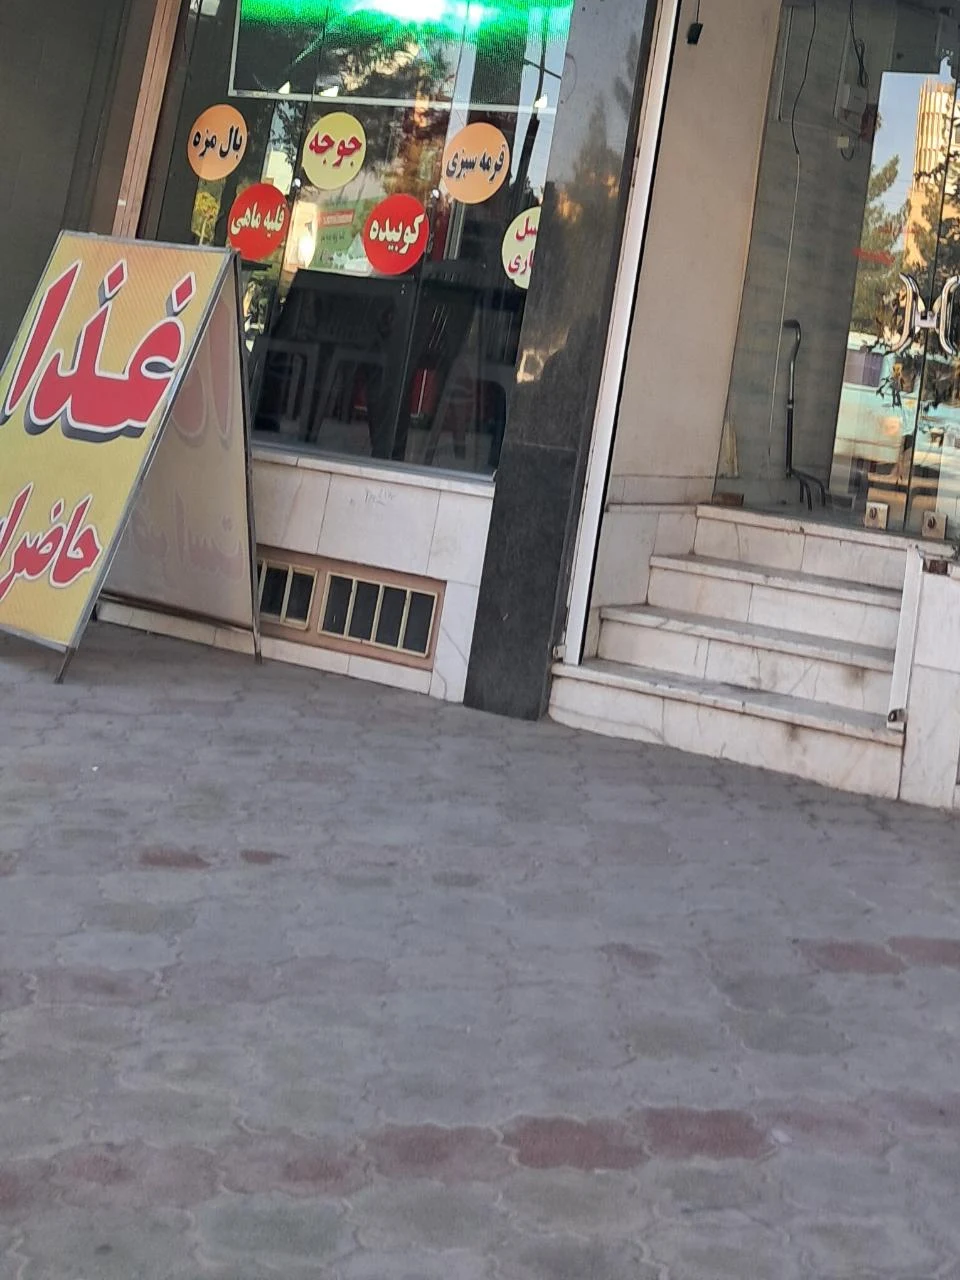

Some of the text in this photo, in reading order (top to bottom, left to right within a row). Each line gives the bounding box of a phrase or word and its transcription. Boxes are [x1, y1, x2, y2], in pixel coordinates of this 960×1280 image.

[219, 125, 243, 160] بال
[308, 131, 363, 168] جوجه
[445, 148, 478, 179] سبزی
[230, 201, 262, 235] ماهی
[369, 213, 426, 255] کوبیده
[4, 258, 197, 440] غذا
